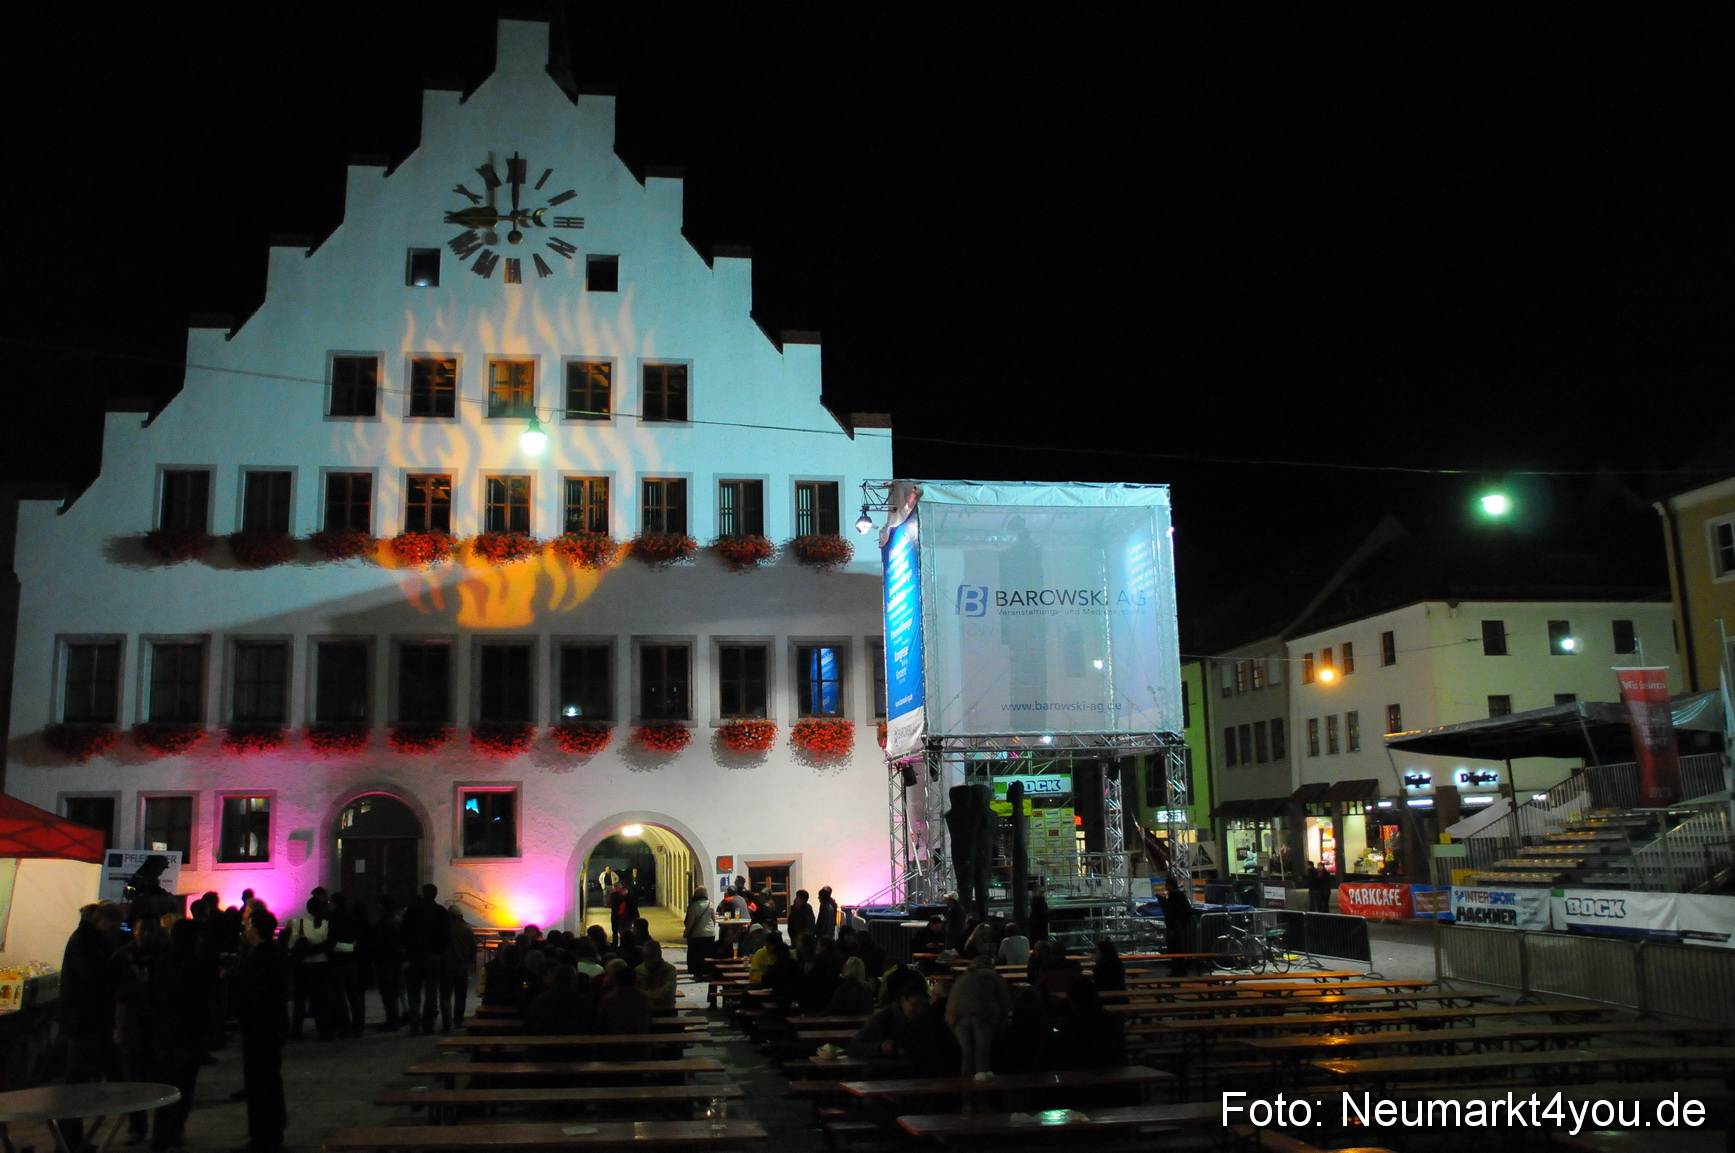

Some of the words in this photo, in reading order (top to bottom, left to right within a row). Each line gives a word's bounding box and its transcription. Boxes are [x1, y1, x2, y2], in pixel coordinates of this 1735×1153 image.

[1465, 890, 1516, 905] INTERSPORT
[1565, 897, 1627, 918] BOCK
[1456, 906, 1517, 926] HACKNER
